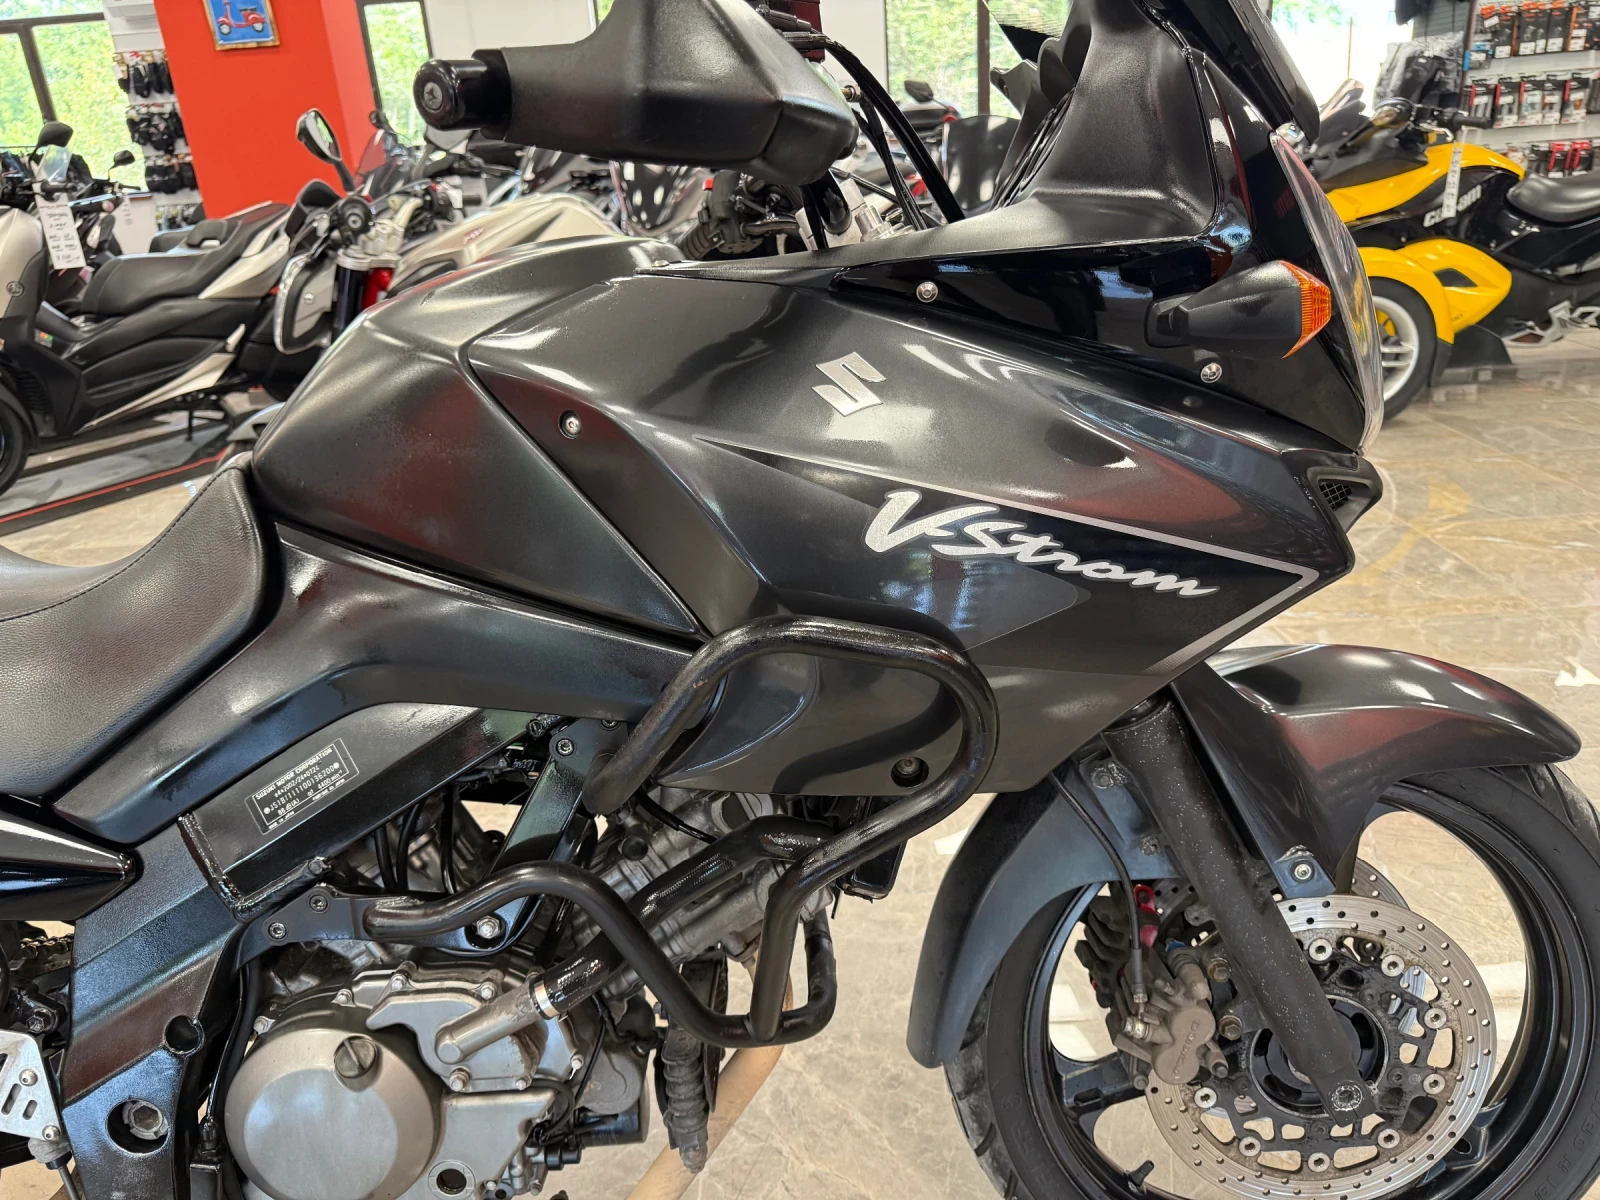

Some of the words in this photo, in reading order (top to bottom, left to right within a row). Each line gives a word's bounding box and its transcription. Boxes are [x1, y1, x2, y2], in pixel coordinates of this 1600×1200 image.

[256, 785, 276, 800] SUZUKI
[276, 771, 295, 786] MOTOR
[295, 748, 332, 774] CORPORATION
